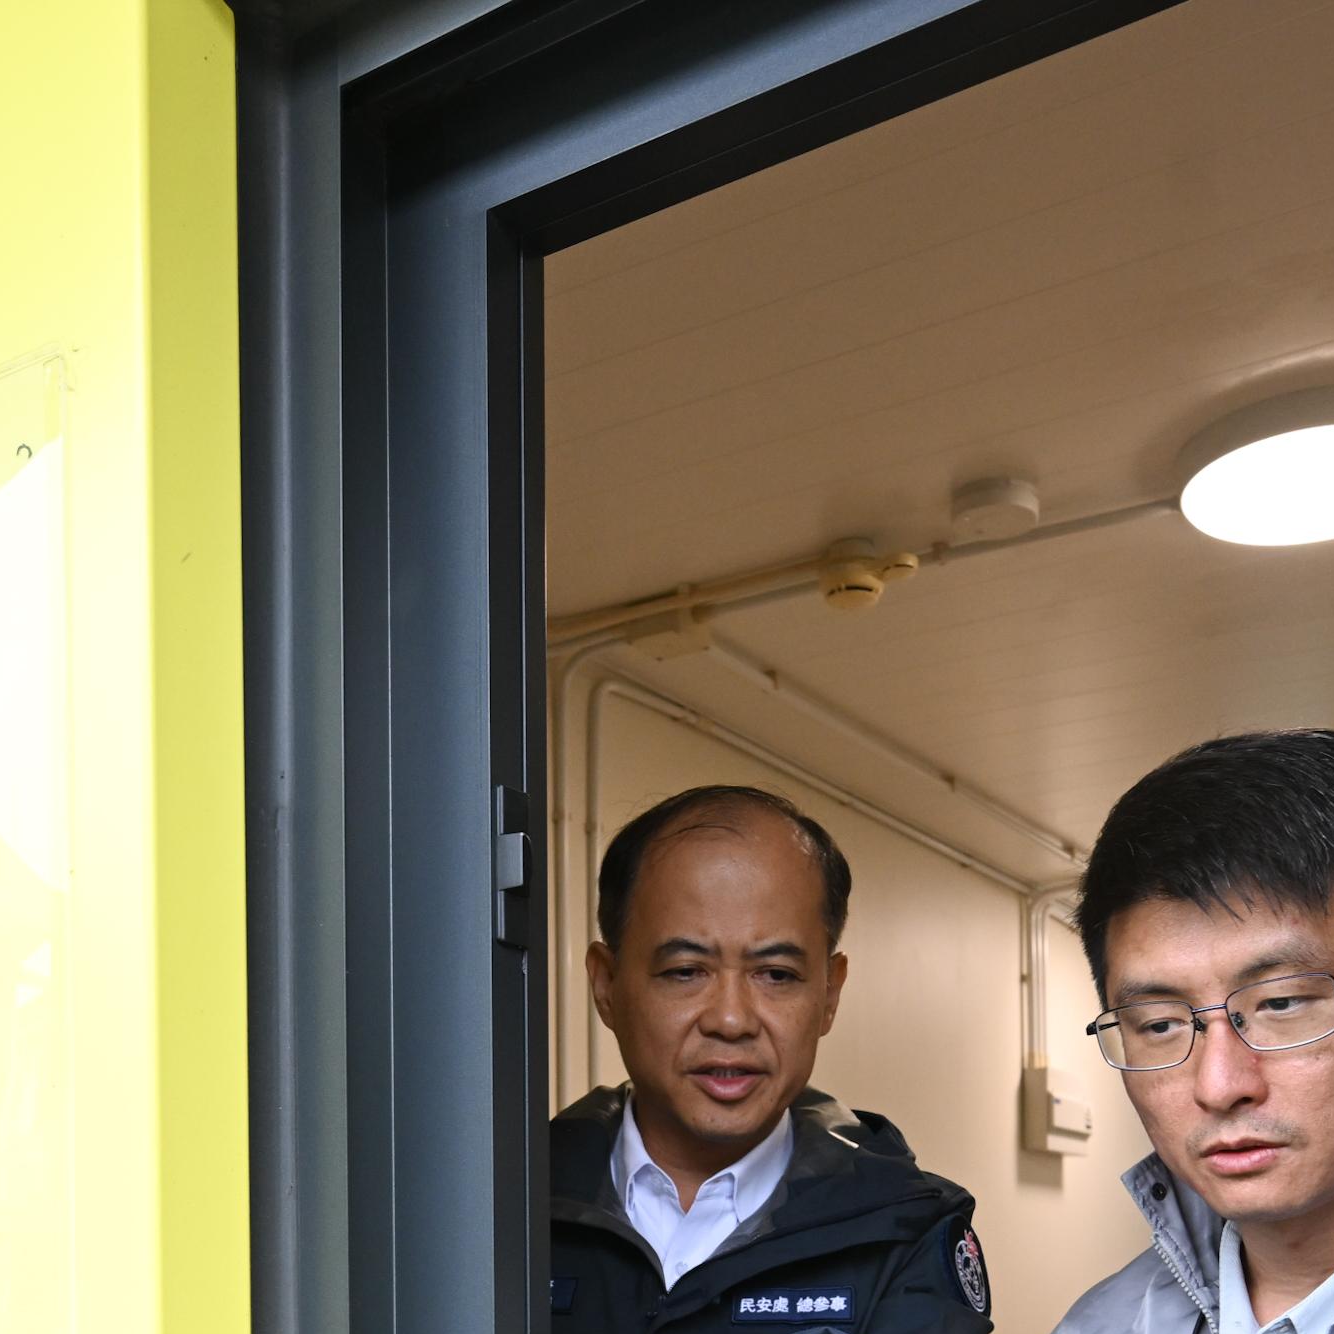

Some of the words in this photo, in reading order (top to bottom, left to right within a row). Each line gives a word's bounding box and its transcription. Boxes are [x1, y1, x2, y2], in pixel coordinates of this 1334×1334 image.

[739, 1295, 789, 1313] 民安處
[796, 1295, 847, 1313] 總參事
